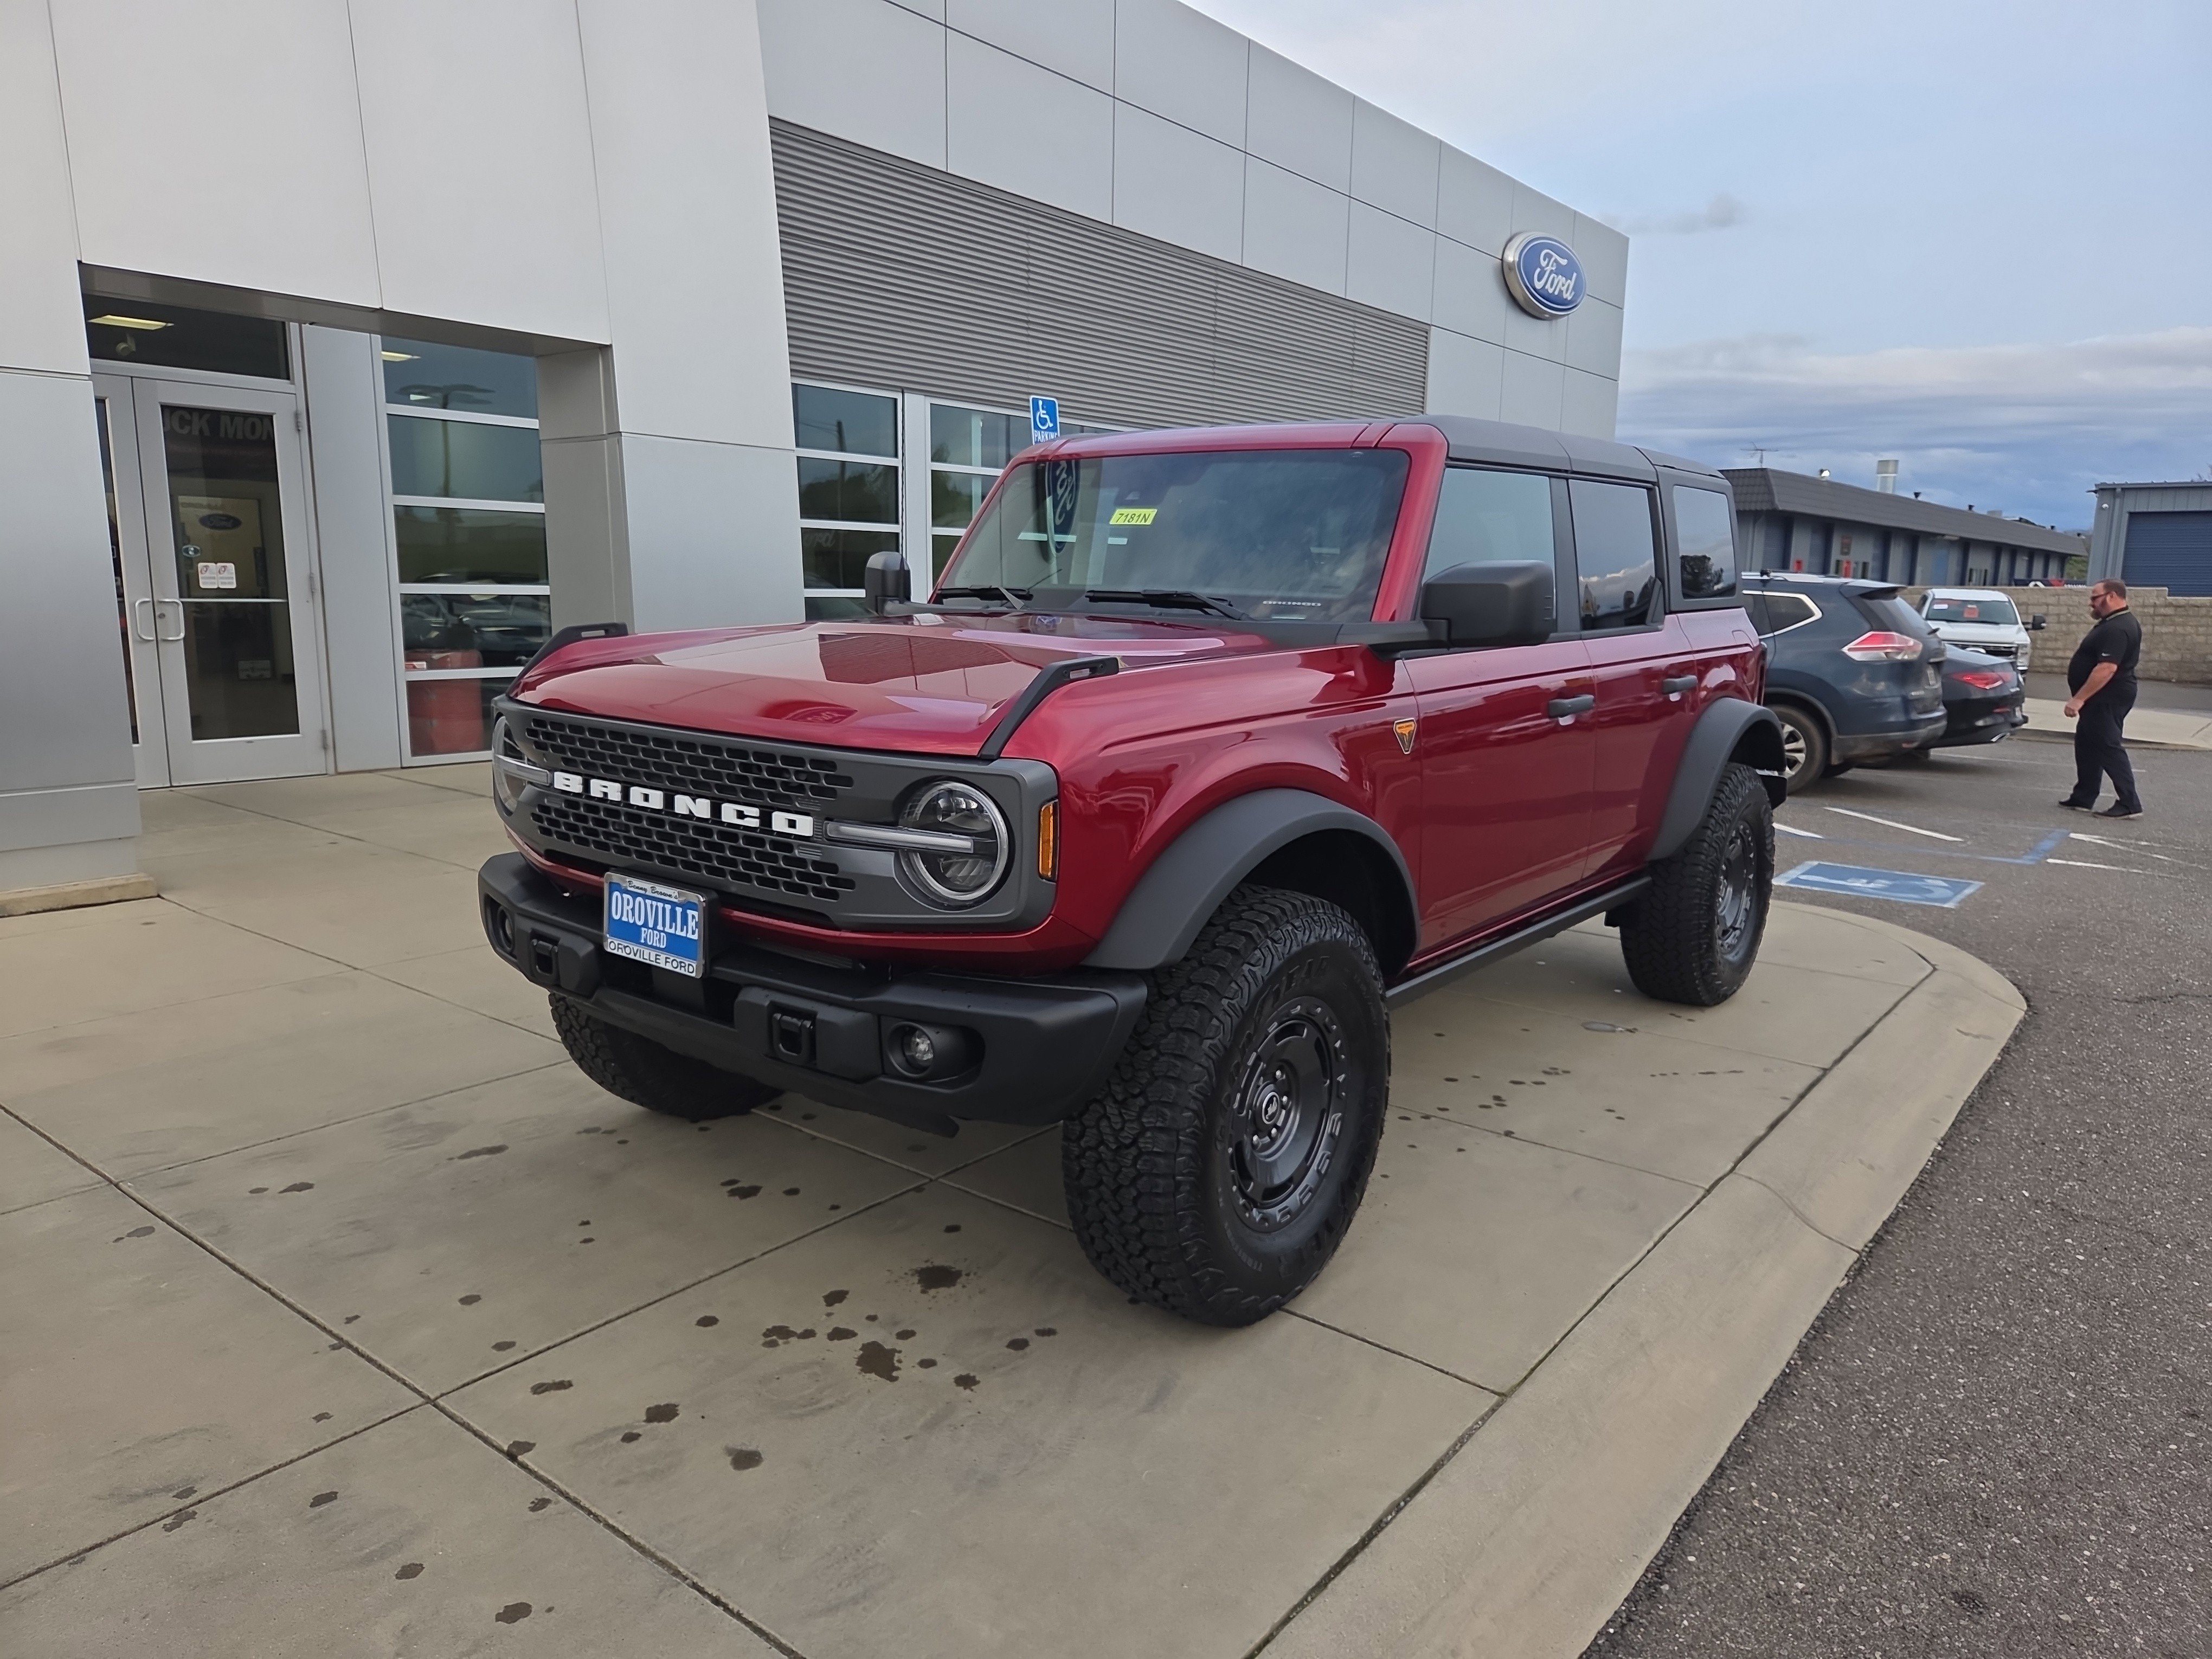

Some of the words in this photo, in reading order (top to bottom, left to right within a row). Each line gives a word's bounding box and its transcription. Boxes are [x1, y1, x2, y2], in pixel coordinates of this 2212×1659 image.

[1534, 249, 1577, 300] Ford
[1115, 513, 1151, 523] 7181N
[554, 771, 813, 837] BRONCO
[627, 880, 648, 894] Benny
[612, 891, 698, 940] OROVILLE
[640, 927, 667, 949] FORD
[609, 940, 661, 964] OROVILLE
[665, 956, 695, 974] FORD
